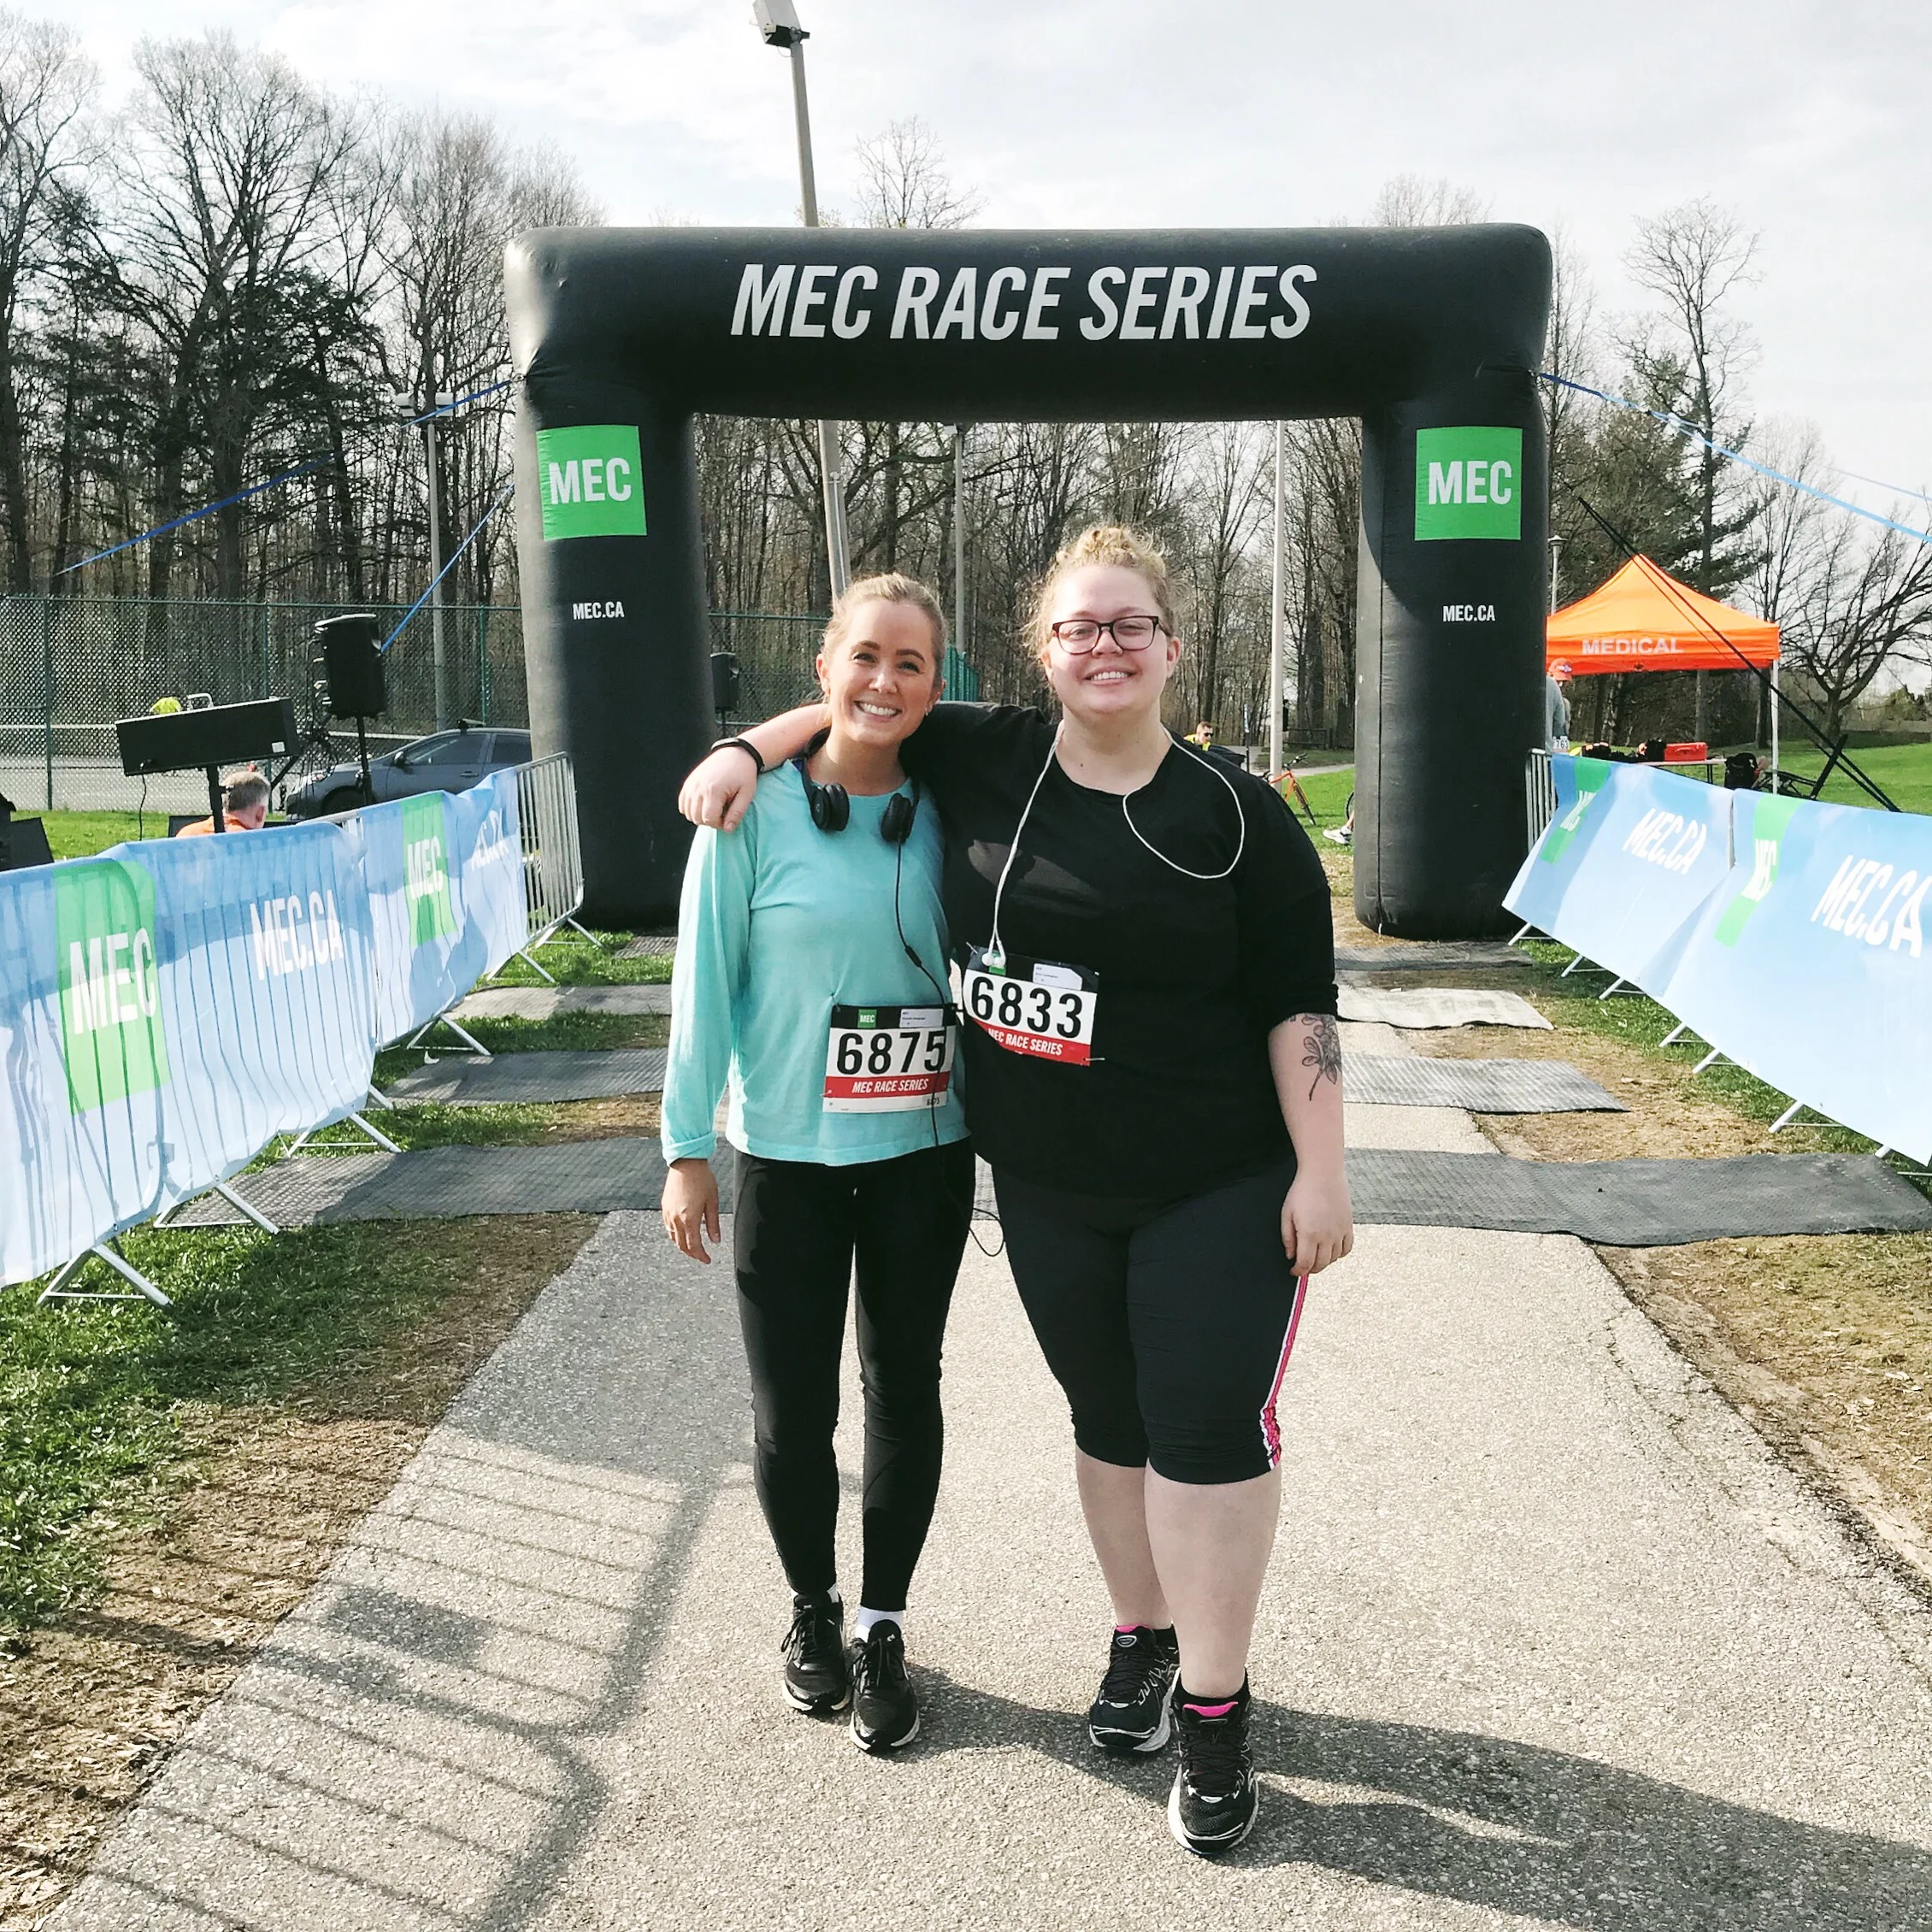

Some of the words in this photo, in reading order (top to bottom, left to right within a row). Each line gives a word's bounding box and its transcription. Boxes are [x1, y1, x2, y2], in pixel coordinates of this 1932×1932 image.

[730, 263, 879, 339] MEC
[889, 265, 1071, 340] RACE
[1079, 264, 1318, 340] SERIES
[548, 457, 633, 504] MEC
[1428, 460, 1512, 505] MEC
[573, 601, 625, 620] MEC.CA
[1442, 604, 1495, 622] MEC.CA
[1582, 637, 1684, 656] MEDICAL
[1622, 807, 1706, 875] MEC.CA
[407, 835, 444, 900] MEC
[1811, 854, 1932, 958] MEC.CA
[249, 888, 344, 981] MEC.CA
[69, 927, 156, 1035] MEC
[859, 1014, 875, 1023] MEC
[971, 976, 1083, 1039] 6833
[836, 1029, 946, 1075] 6875
[1005, 1033, 1029, 1050] RACE
[1029, 1038, 1063, 1057] SERIES
[851, 1081, 873, 1093] MEC
[874, 1079, 898, 1093] RACE
[898, 1078, 929, 1091] SERIES
